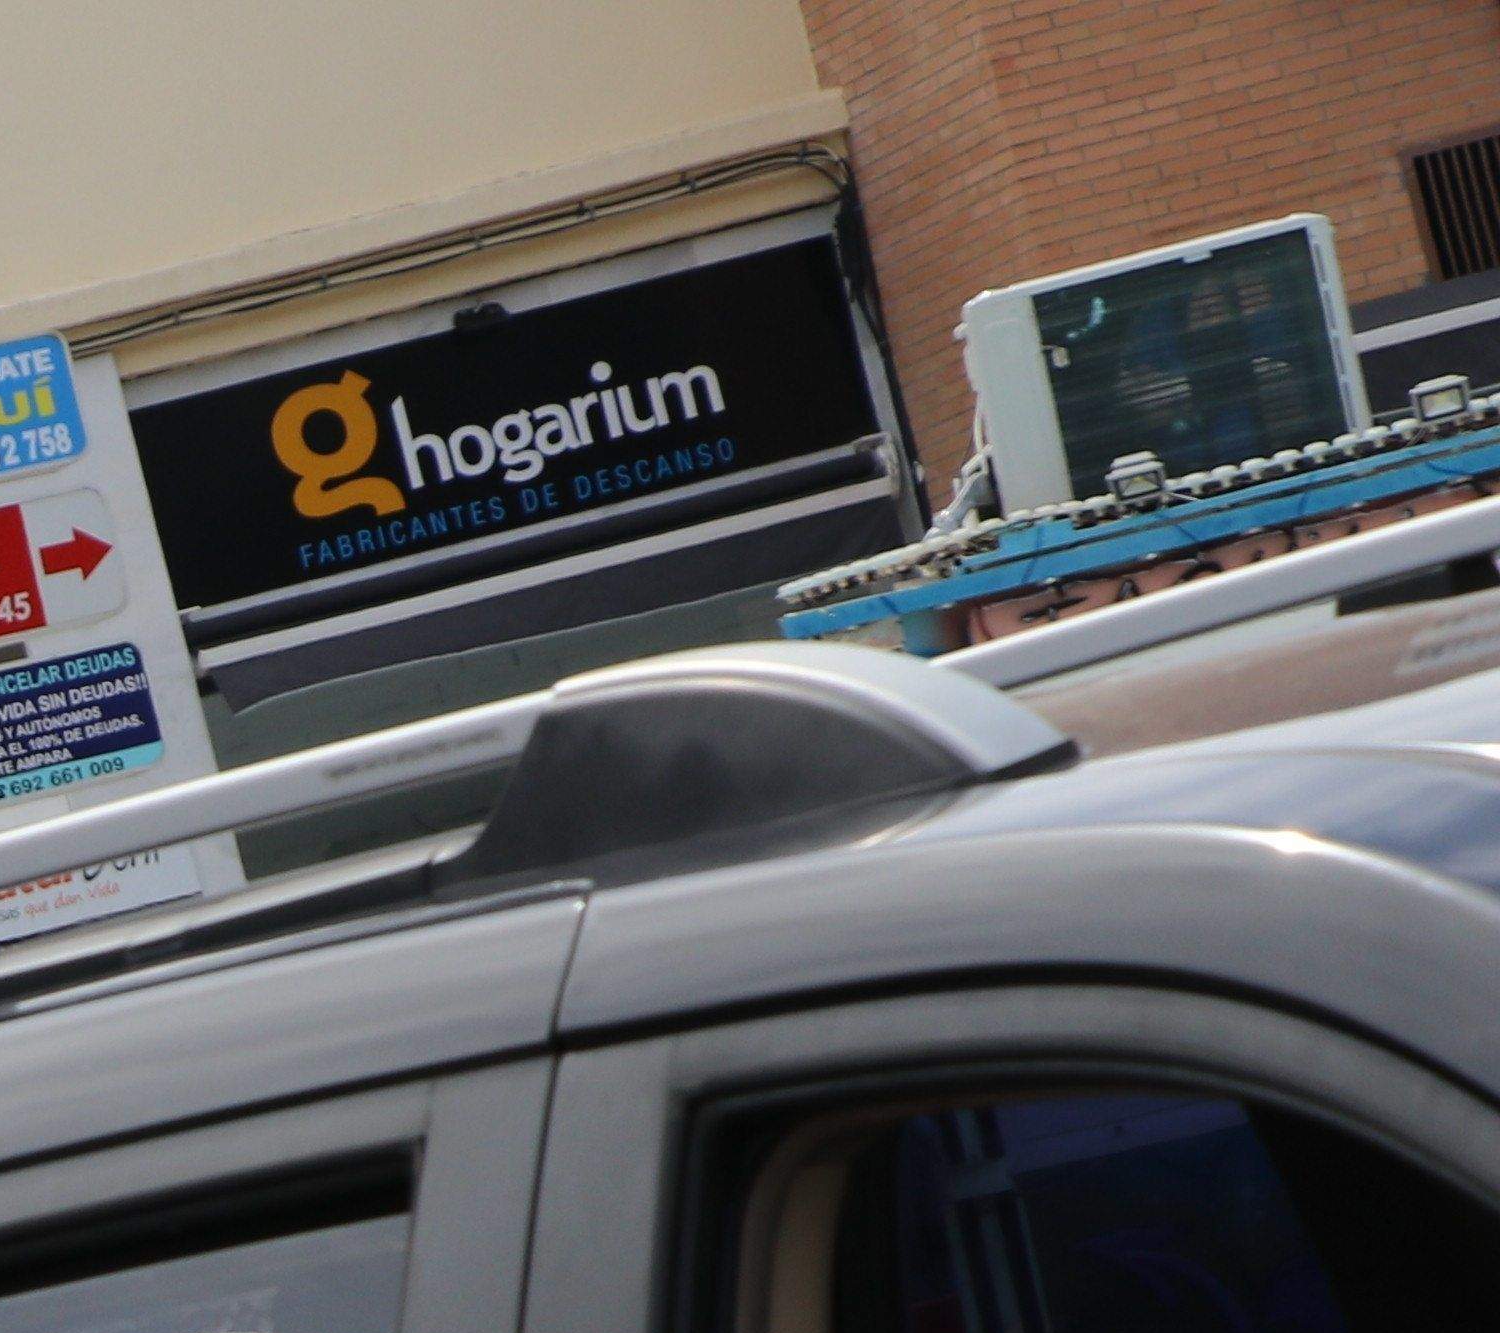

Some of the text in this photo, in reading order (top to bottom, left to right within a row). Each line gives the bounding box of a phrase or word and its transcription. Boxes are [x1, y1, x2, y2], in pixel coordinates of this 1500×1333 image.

[24, 423, 73, 459] 758
[390, 360, 726, 491] hogarium
[299, 436, 736, 571] FABRICANTES DE DESCANSO
[64, 647, 136, 680] DEUDAS
[37, 691, 67, 713] SIN
[68, 672, 149, 704] DEUDAS!!
[3, 725, 15, 740] Y
[8, 741, 28, 757] EL
[63, 727, 83, 744] DE
[10, 756, 125, 795] 692 661 009
[15, 747, 73, 771] AMPARA
